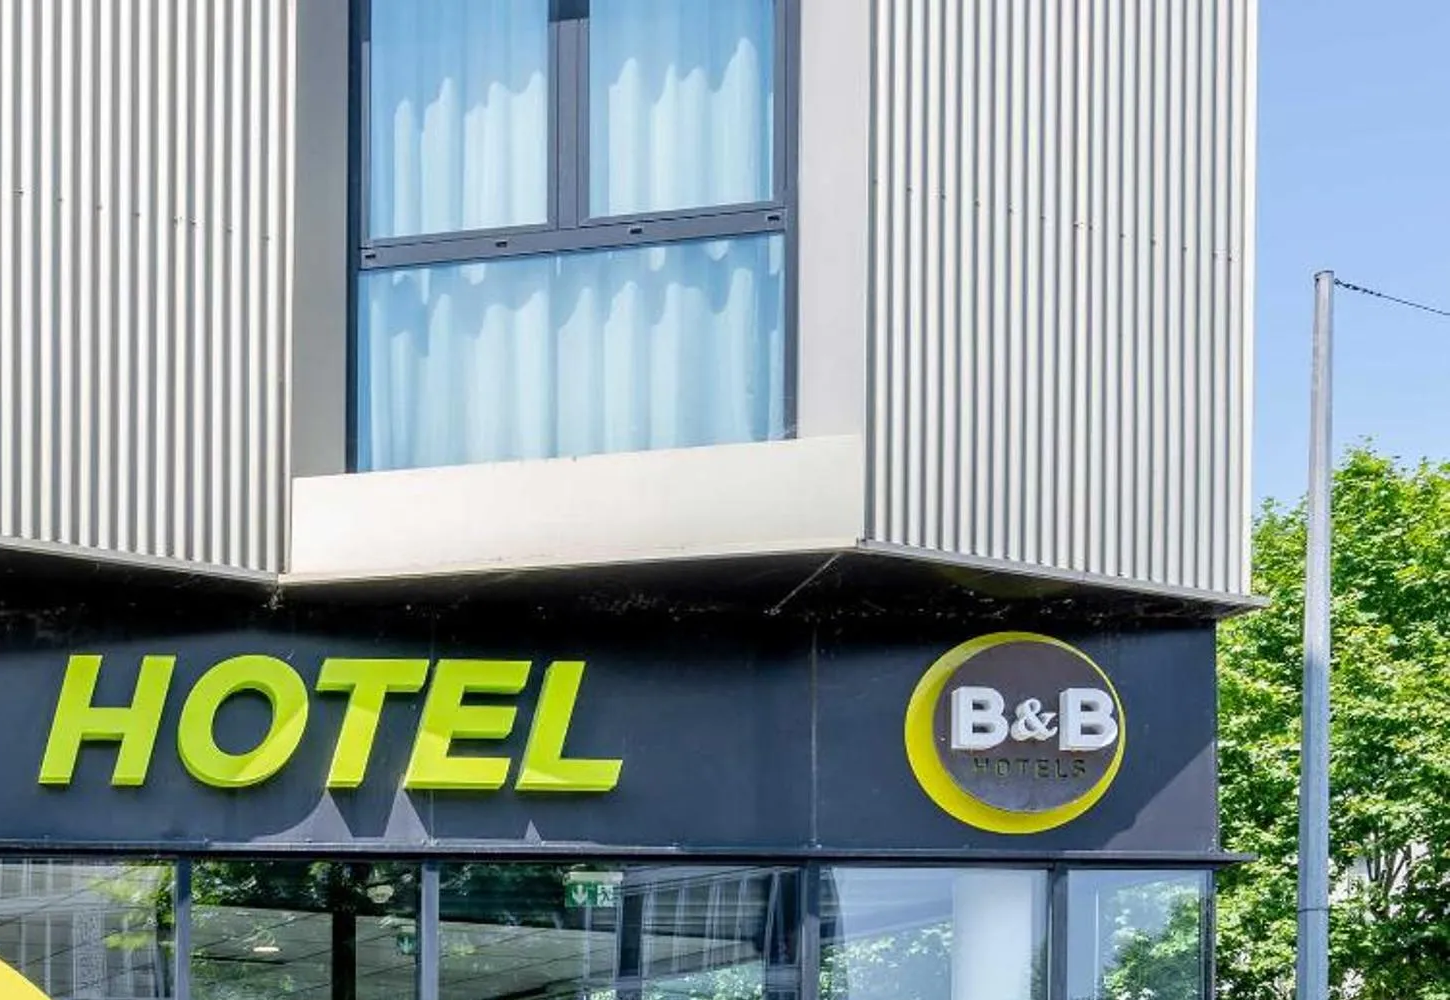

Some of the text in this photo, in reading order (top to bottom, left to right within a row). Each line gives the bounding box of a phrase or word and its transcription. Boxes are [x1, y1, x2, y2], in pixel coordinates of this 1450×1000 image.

[38, 655, 623, 791] HOTEL
[951, 686, 1118, 751] B&B
[971, 757, 1087, 779] HOTELS
